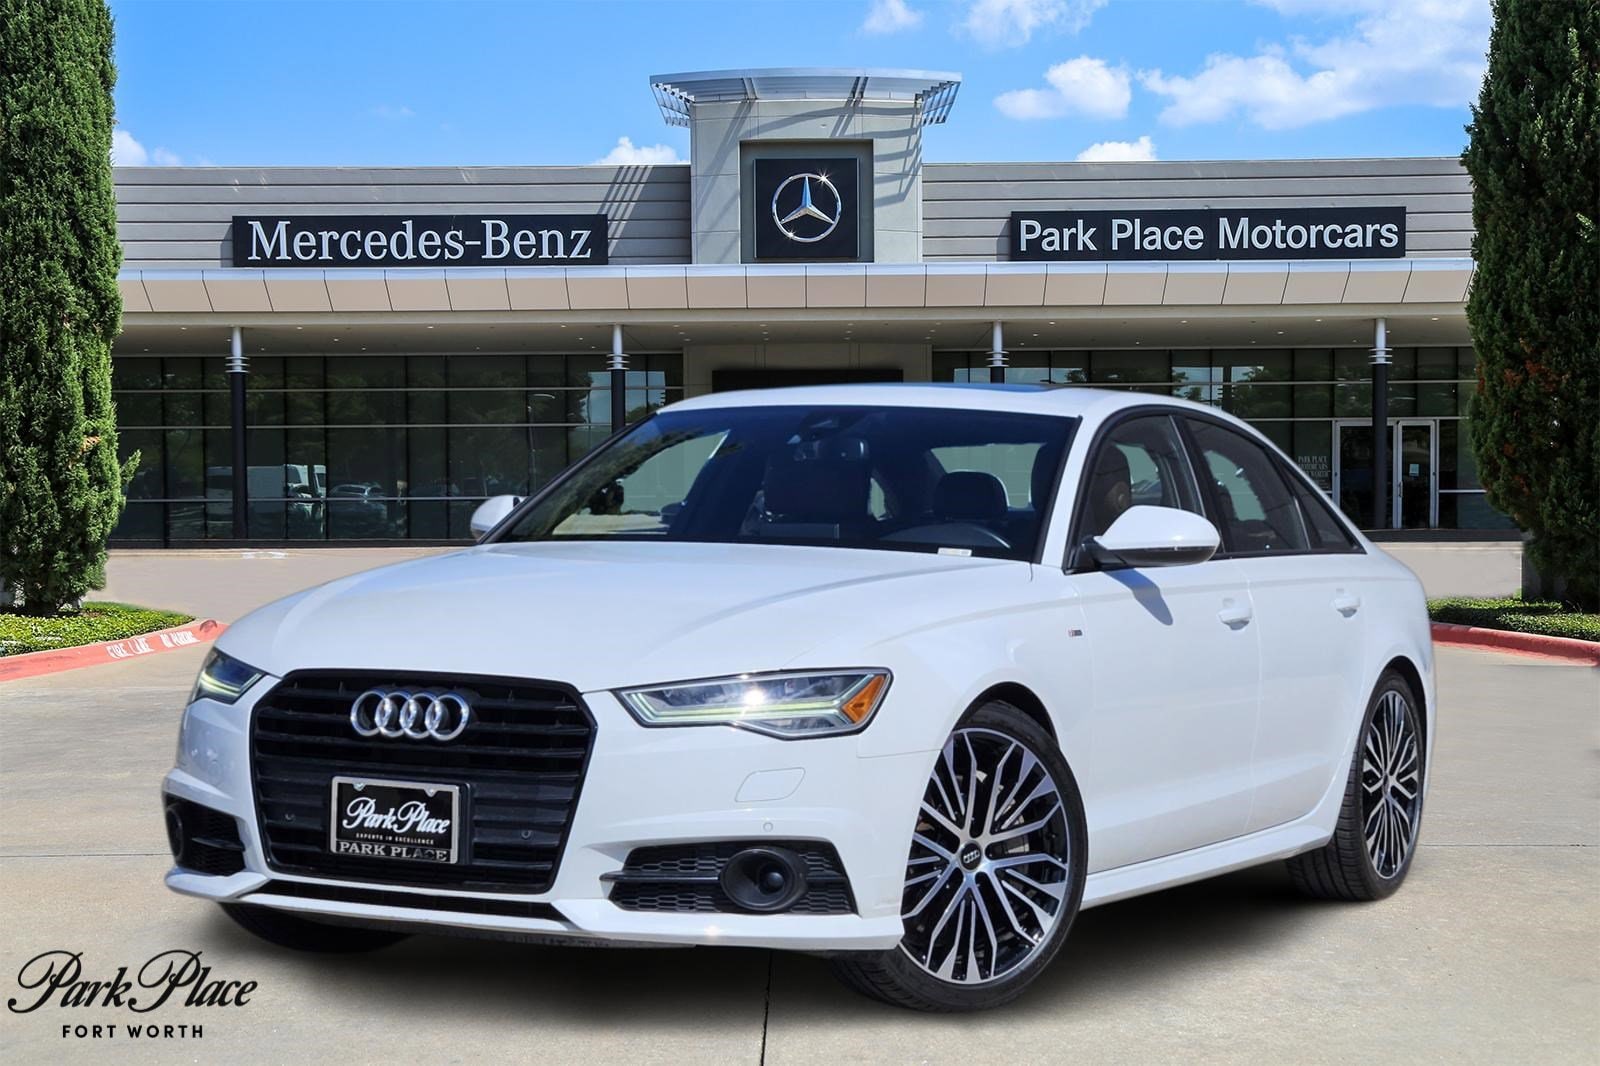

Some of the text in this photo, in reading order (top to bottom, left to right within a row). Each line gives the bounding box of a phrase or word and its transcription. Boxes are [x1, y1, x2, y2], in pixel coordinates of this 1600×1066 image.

[247, 219, 592, 261] Mercedes-Benz
[1019, 217, 1399, 252] Park Place Motorcars
[342, 797, 450, 834] Park Place
[339, 841, 448, 862] PARK PLACE
